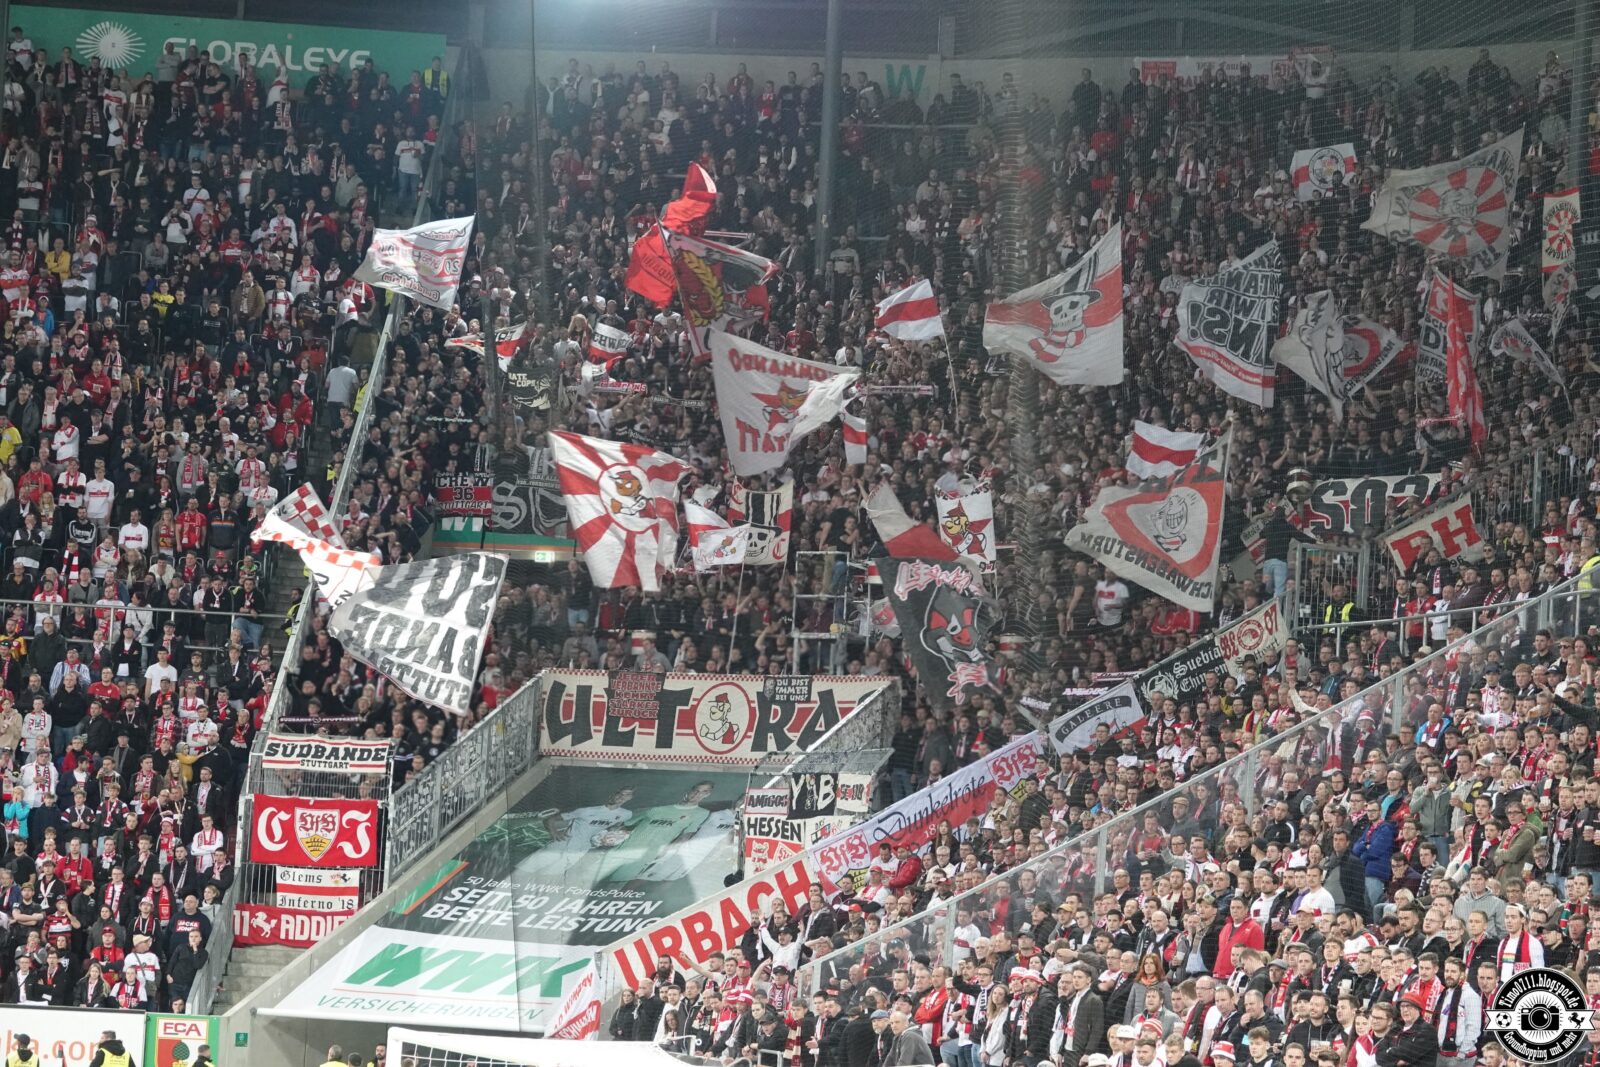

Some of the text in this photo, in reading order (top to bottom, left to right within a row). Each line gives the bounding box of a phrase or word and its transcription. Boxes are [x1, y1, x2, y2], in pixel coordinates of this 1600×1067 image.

[453, 487, 475, 501] 36
[1172, 645, 1221, 680] Suebia
[1179, 663, 1229, 693] Ehinen
[1060, 697, 1123, 736] GALEERE
[264, 742, 388, 762] SÜDBANDE
[300, 759, 350, 770] STUTTGART
[872, 775, 986, 842] Dunkelrote
[257, 806, 292, 852] C
[746, 817, 802, 843] HESSEN
[280, 869, 323, 884] Glems
[463, 876, 483, 886] 50
[484, 879, 521, 892] Jahre
[522, 883, 562, 894] WWK
[278, 894, 333, 910] Inferno
[442, 886, 664, 917] SEIT 50 JAHREN
[421, 902, 511, 928] BESTE
[613, 858, 813, 993] URBACH
[341, 943, 593, 997] WWK
[316, 995, 544, 1020] VERSICHERUNGEN
[163, 1022, 202, 1036] FCA
